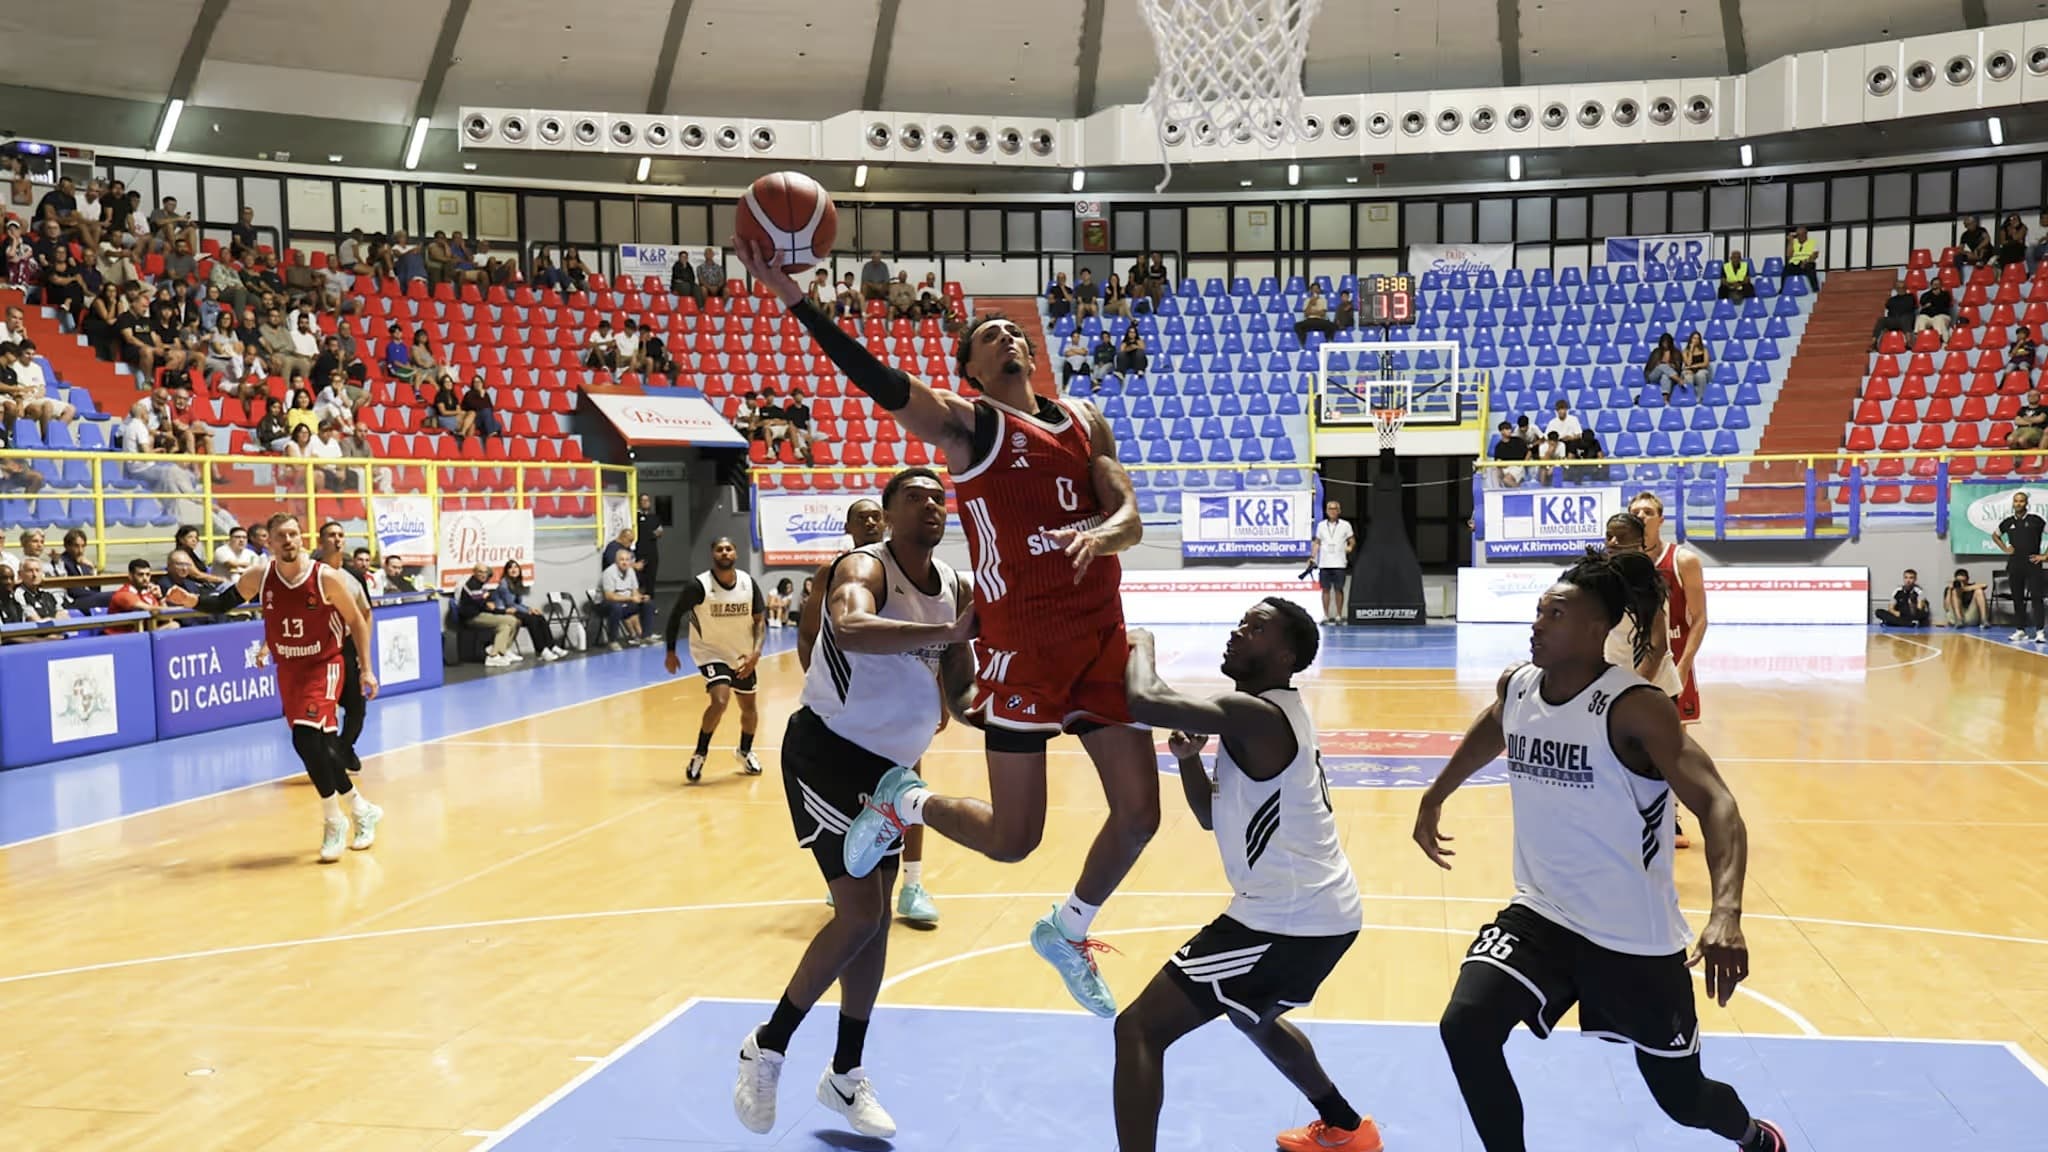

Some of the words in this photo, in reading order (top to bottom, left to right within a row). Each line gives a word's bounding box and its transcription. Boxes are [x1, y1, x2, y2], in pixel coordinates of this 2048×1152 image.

[640, 248, 667, 263] K&R
[1644, 241, 1703, 273] K&R
[1376, 277, 1408, 292] 3:38
[1382, 292, 1408, 319] 13
[785, 514, 849, 532] Sardin
[1235, 498, 1289, 527] K&R
[1540, 496, 1597, 525] K&R
[1235, 527, 1290, 537] IMMOBILIARE
[1540, 525, 1598, 535] IMMOBILIARE
[458, 527, 524, 564] Petrarca
[1187, 542, 1307, 554] www.KRimmobiliare.it
[1703, 580, 1853, 591] oysardinia.net
[281, 617, 304, 639] 13
[168, 646, 222, 680] CITTÀ
[170, 688, 189, 713] DI
[195, 675, 276, 709] CAGLIARI
[1588, 690, 1611, 716] 35
[1528, 738, 1593, 771] ASVEL
